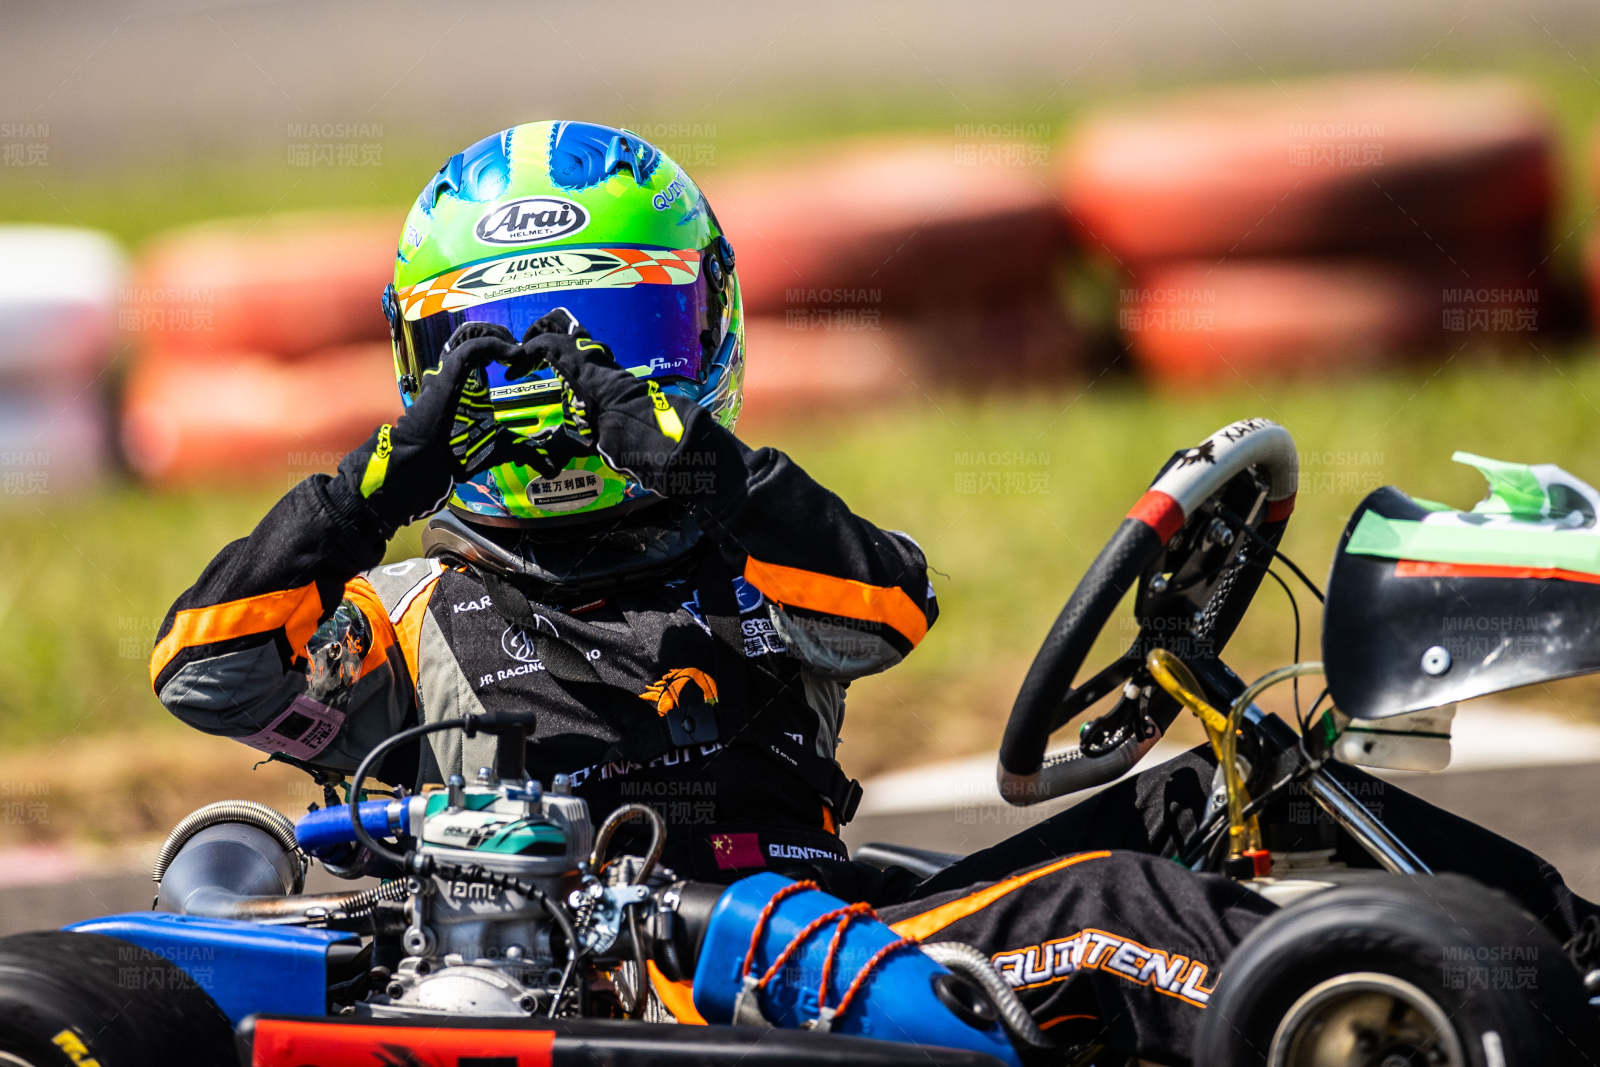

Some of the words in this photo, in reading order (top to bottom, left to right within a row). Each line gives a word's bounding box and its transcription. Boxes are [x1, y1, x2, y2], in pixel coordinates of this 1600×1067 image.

[484, 204, 572, 237] Arai
[506, 255, 564, 274] LUCKY
[500, 267, 573, 283] DESIGN
